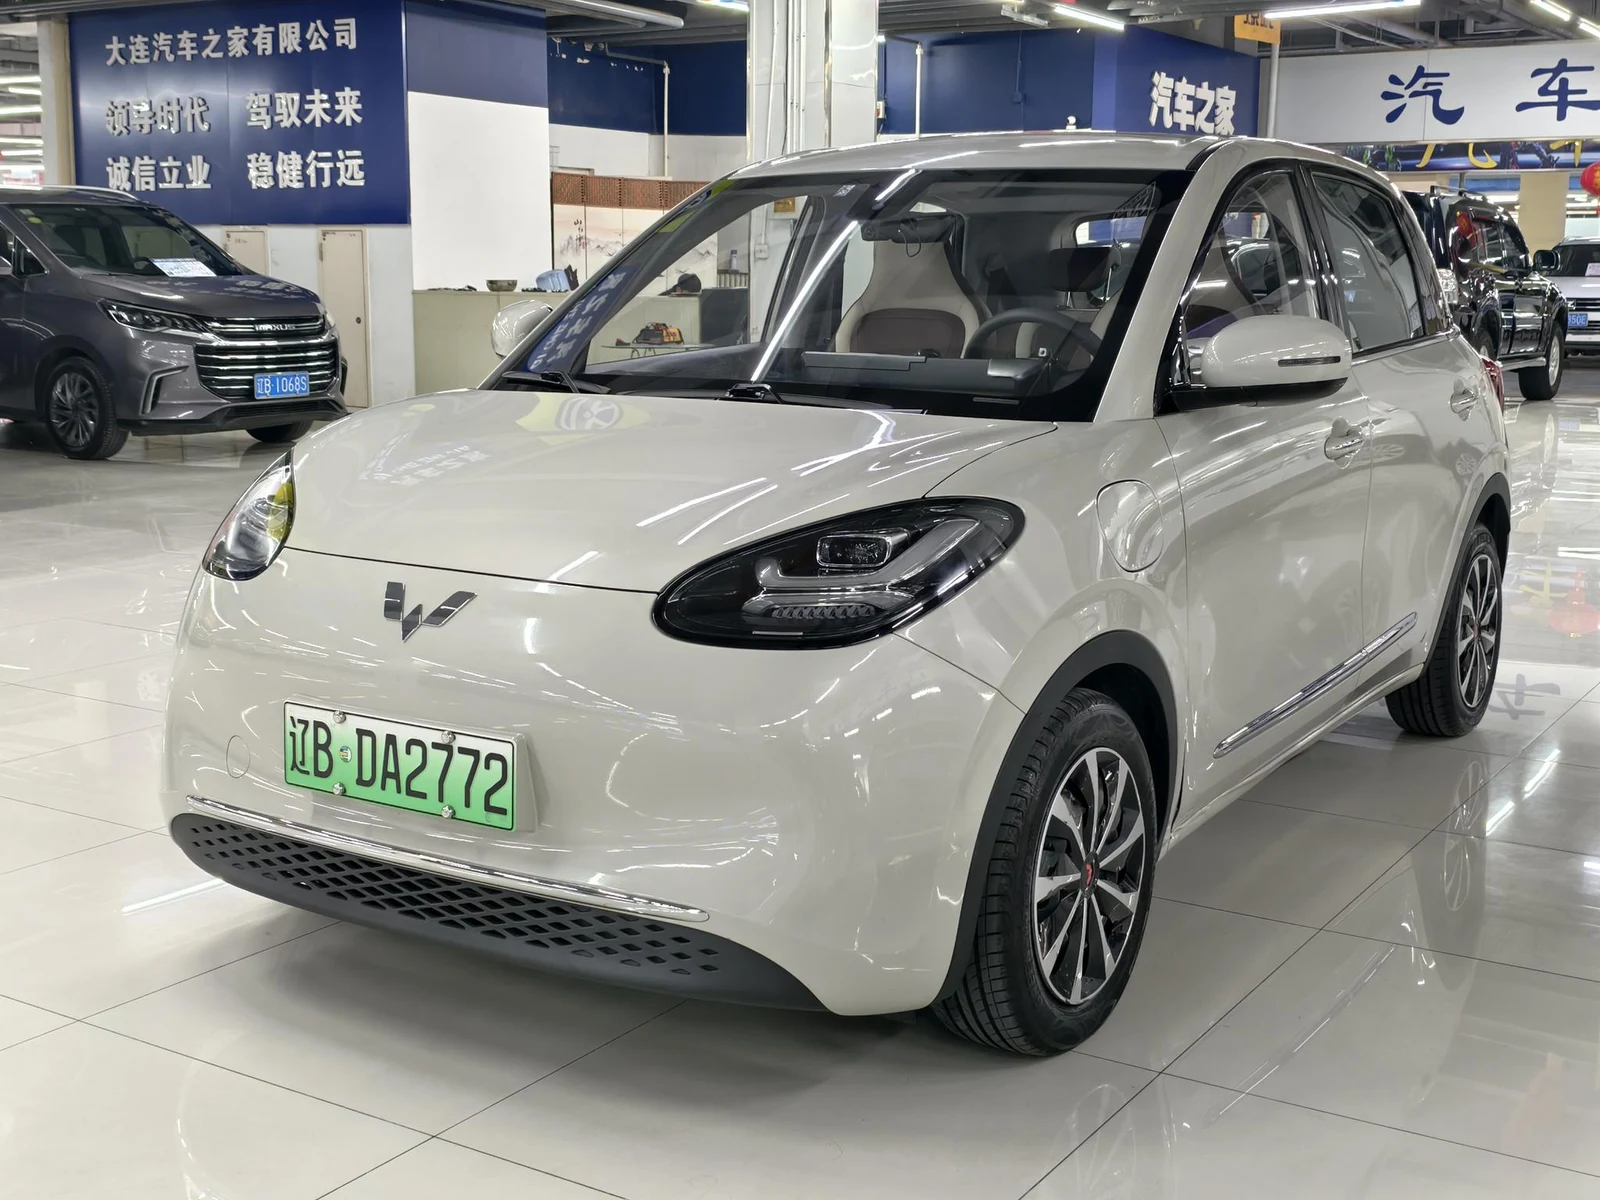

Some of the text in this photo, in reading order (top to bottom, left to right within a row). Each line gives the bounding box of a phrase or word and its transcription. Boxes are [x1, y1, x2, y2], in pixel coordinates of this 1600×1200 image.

[105, 18, 358, 66] 大连汽车之家有限公司
[106, 86, 364, 136] 领导时代 驾驭未来
[1149, 70, 1237, 136] 汽车之家
[106, 150, 366, 192] 诚信立业 稳健行远
